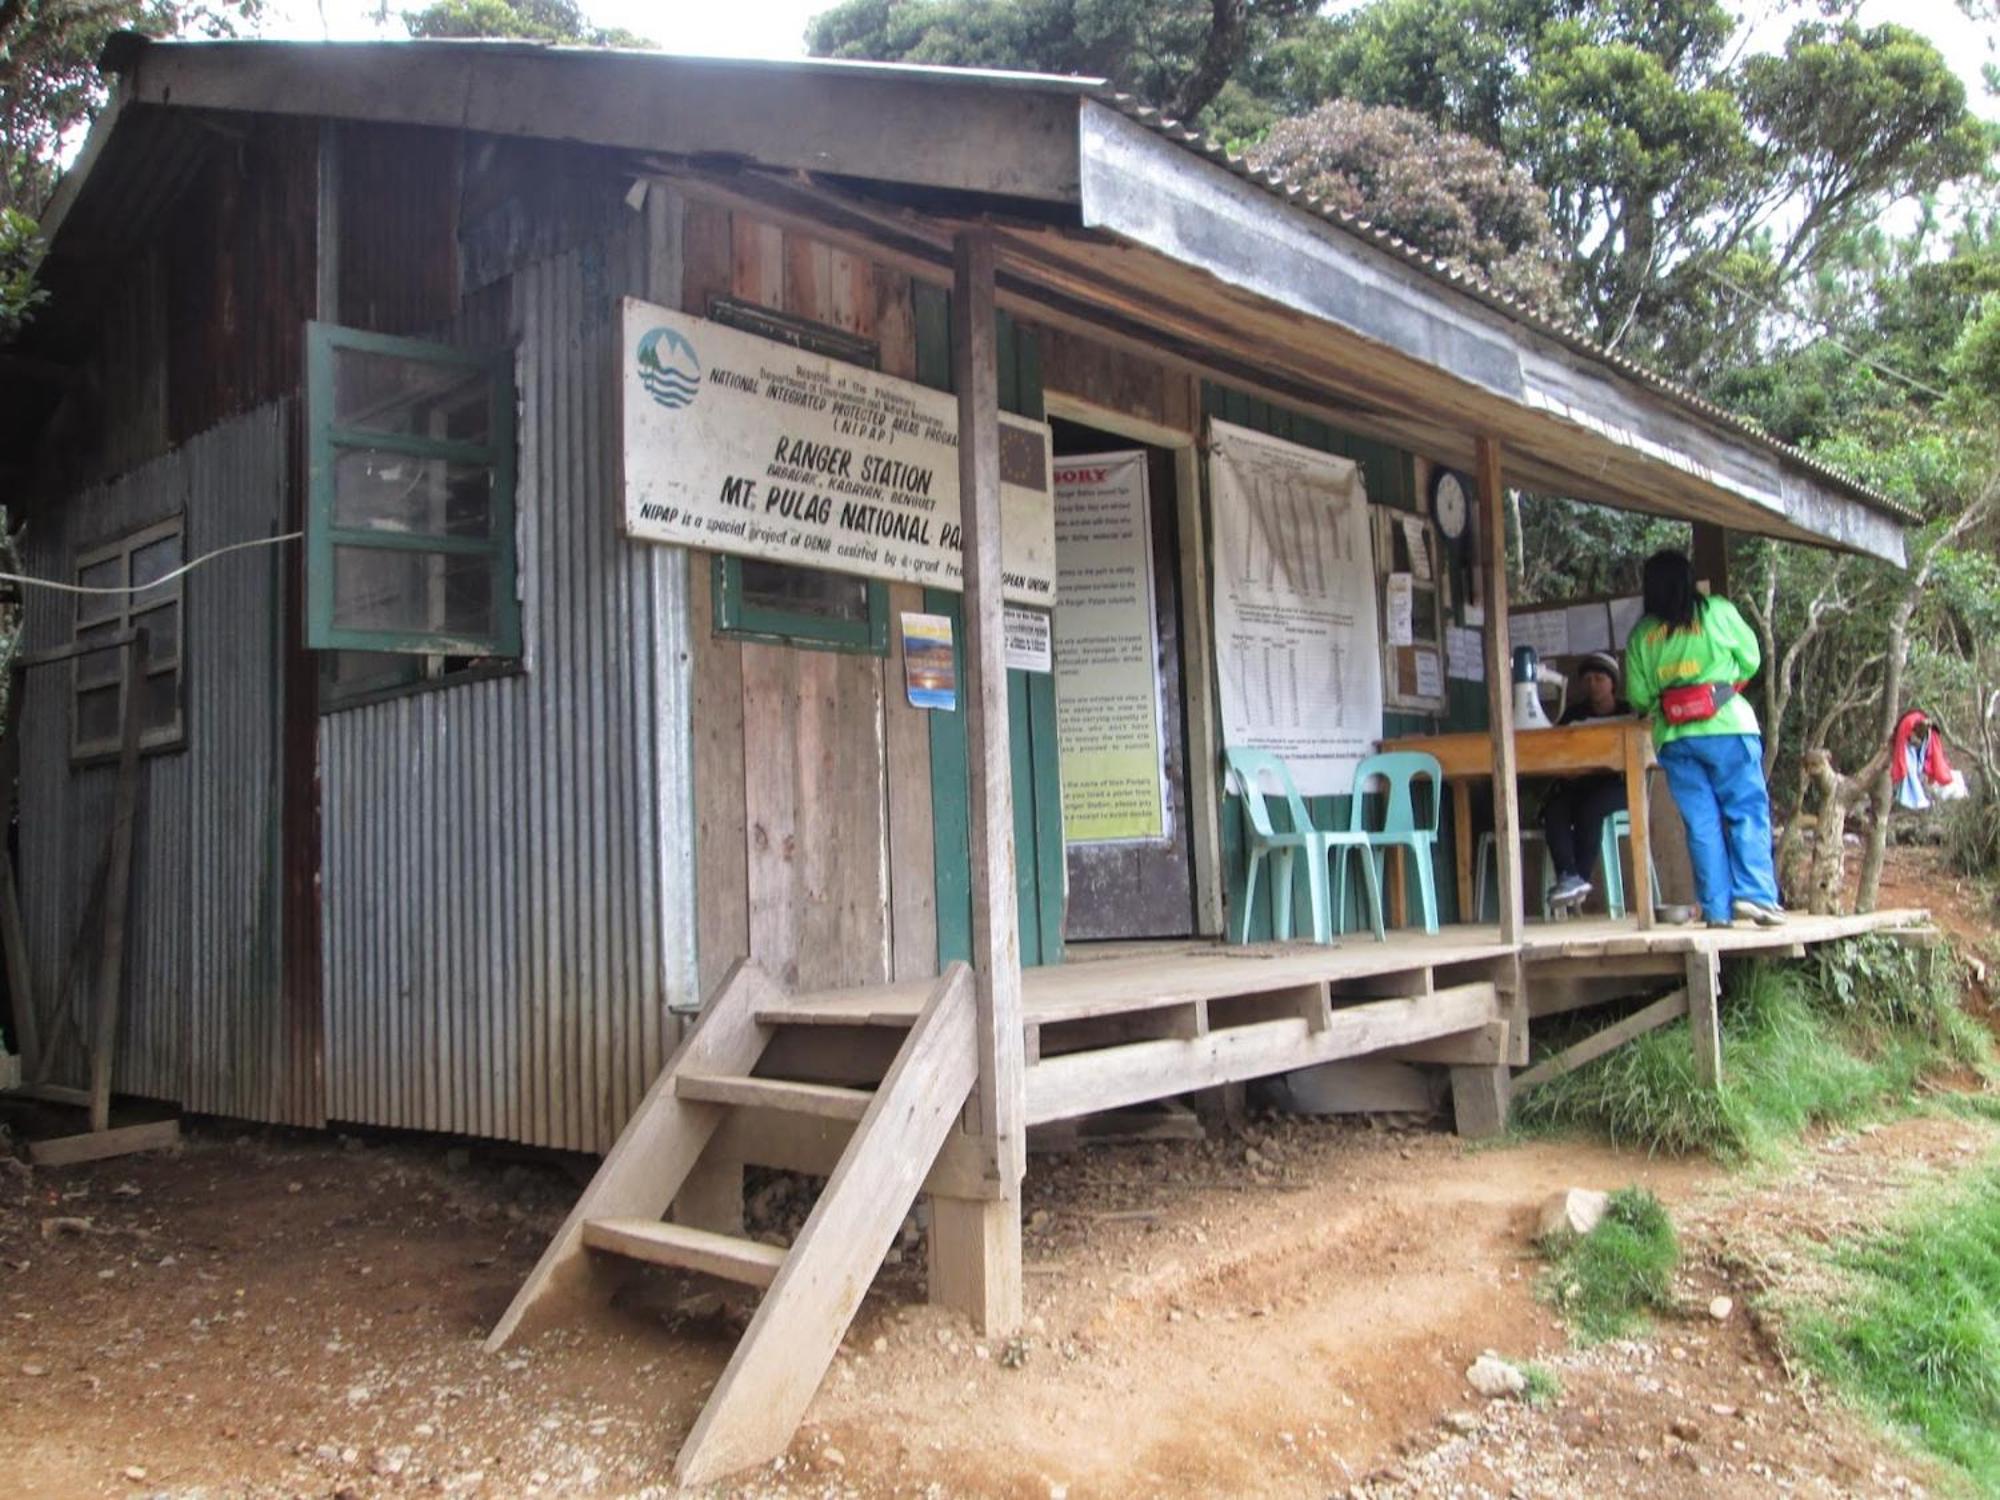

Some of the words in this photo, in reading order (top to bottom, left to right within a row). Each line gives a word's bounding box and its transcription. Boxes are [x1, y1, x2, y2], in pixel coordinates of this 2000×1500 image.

[709, 367, 758, 395] NATIONAL
[766, 384, 827, 411] INTEGRATED
[832, 401, 886, 426] PROTECTED
[892, 416, 920, 437] AREAS
[925, 426, 960, 448] PROGRA
[775, 435, 851, 479] RANGER
[861, 454, 934, 496] STATION
[640, 502, 679, 524] NIPAP
[682, 510, 692, 526] is
[694, 517, 702, 529] a
[706, 518, 748, 537] special
[749, 521, 788, 546] project
[790, 533, 801, 547] of
[803, 534, 832, 555] DENR
[837, 545, 878, 562] assisted
[884, 551, 897, 567] by
[913, 558, 940, 574] grant
[765, 486, 833, 526] PULAG
[840, 500, 930, 546] NATIONAL
[939, 521, 962, 552] PA
